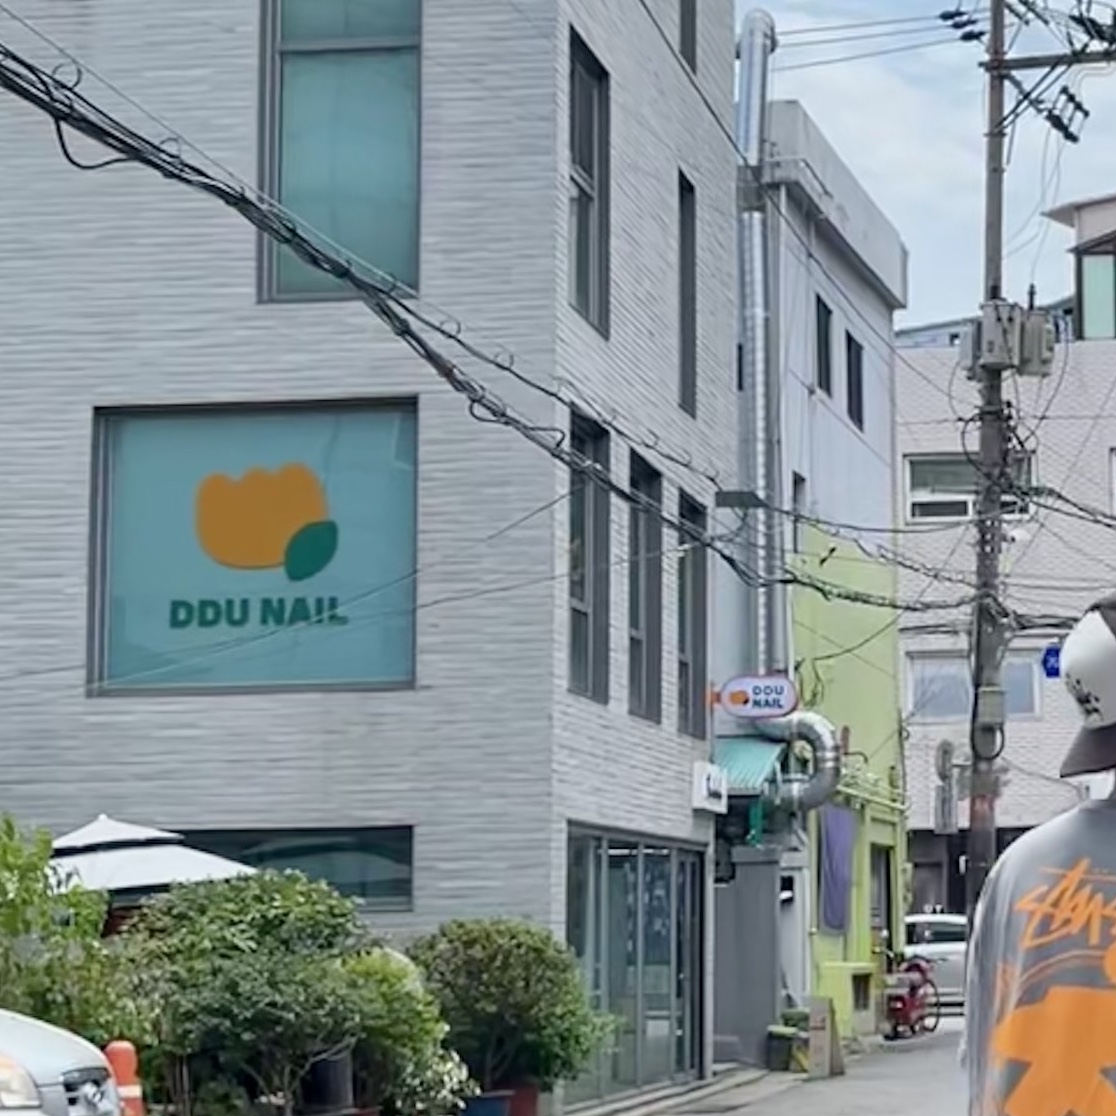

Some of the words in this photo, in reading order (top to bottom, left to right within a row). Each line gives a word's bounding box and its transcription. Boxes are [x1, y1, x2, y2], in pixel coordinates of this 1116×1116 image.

[169, 598, 249, 629] DDU
[260, 595, 349, 626] NAIL
[752, 698, 784, 708] NAIL
